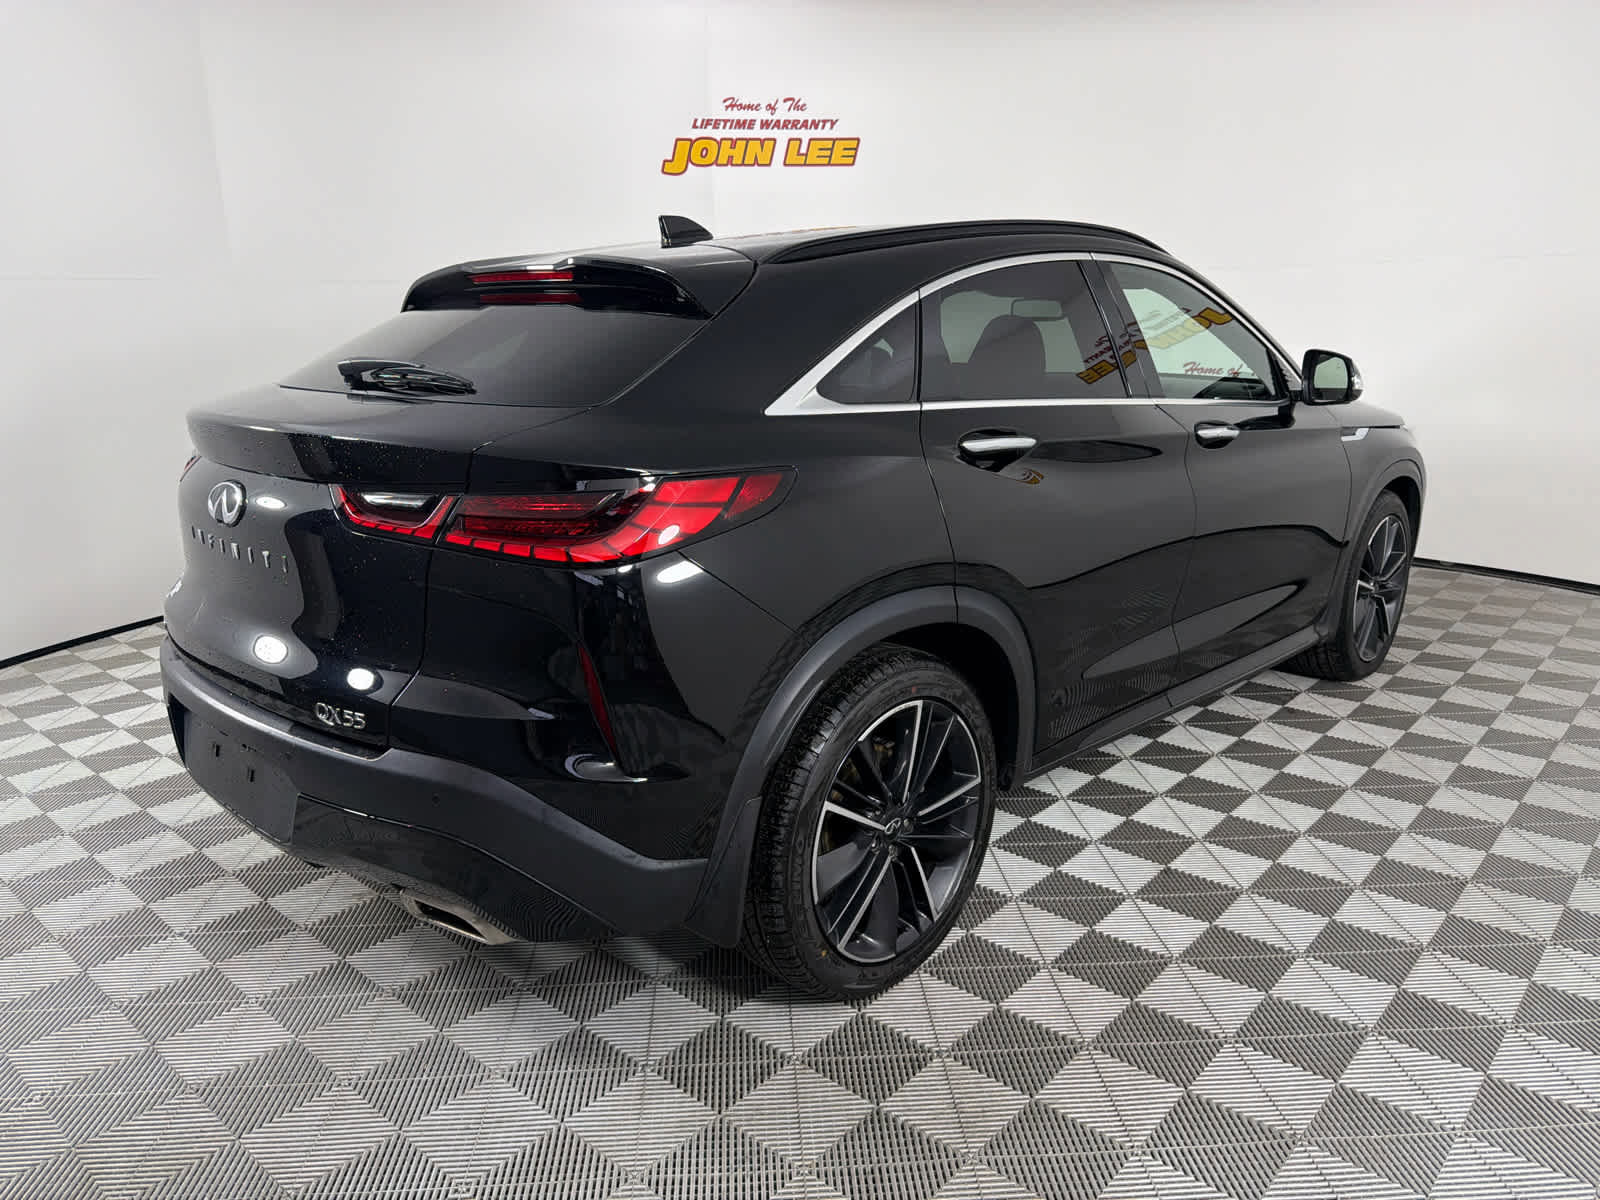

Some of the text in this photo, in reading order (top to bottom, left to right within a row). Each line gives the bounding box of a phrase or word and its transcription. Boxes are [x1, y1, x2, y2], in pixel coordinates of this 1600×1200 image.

[722, 97, 807, 115] Home of The
[691, 118, 839, 131] LIFETIME WARRANTY
[661, 137, 860, 176] JOHN LEE
[315, 702, 366, 729] QX55
